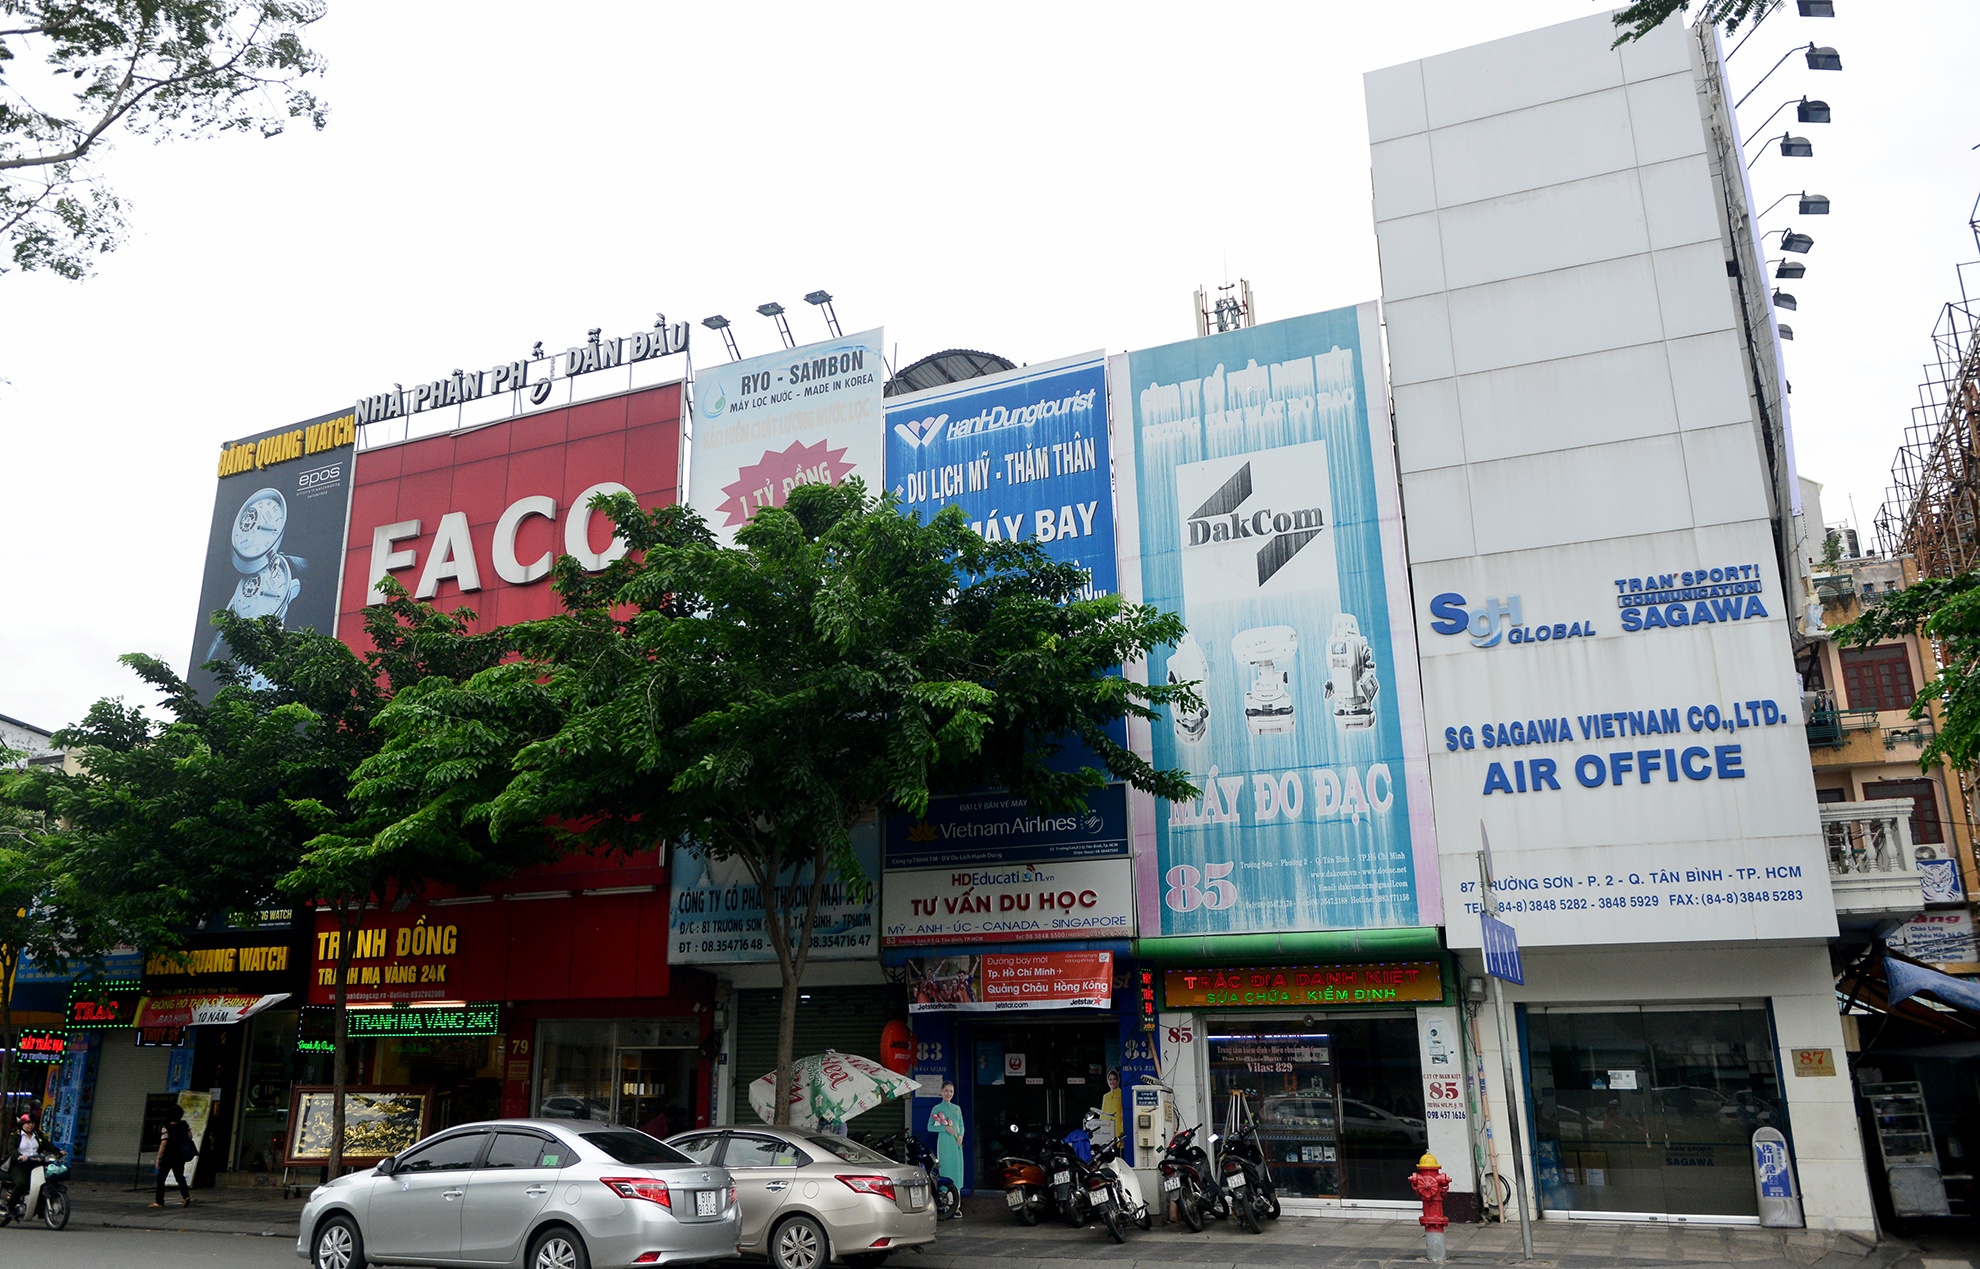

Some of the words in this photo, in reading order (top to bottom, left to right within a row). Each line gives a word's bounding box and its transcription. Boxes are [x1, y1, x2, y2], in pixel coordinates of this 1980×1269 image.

[354, 382, 405, 426] NHÀ
[412, 368, 483, 414] PHÂN
[565, 327, 622, 377] DẪN
[630, 313, 690, 363] ĐẦU
[741, 370, 771, 396] RYO
[789, 349, 864, 386] SAMBON
[730, 399, 749, 414] MÁY
[752, 396, 768, 410] LỌC
[770, 390, 794, 405] NƯỚC
[804, 382, 830, 398] MADE
[832, 380, 842, 391] IN
[844, 372, 874, 388] KOREA
[217, 442, 257, 478] ĐĂNG
[254, 428, 305, 470] QUANG
[304, 413, 355, 456] WATCH
[298, 466, 341, 487] epos
[907, 469, 939, 504] DU
[941, 460, 965, 505] LỊCH
[969, 450, 990, 495] MỸ
[1004, 448, 1050, 485] THĂM
[1053, 430, 1097, 475] THÂN
[1034, 499, 1099, 543] BAY
[1187, 506, 1325, 547] DakCom
[1620, 580, 1760, 606] COMMUNICATION
[1621, 594, 1769, 632] SAGAWA
[1507, 619, 1597, 645] GLOBAL
[1444, 725, 1475, 752] SG
[1481, 716, 1574, 749] SAGAWA
[1577, 706, 1681, 741] VIETNAM
[1482, 757, 1562, 796] AIR
[1573, 743, 1746, 789] OFFICE
[1168, 763, 1245, 827] MÁY
[1252, 770, 1304, 821] ĐO
[1313, 763, 1394, 826] ĐẠC
[940, 821, 1010, 840] Vietnam
[1011, 816, 1077, 834] Airlines
[1165, 860, 1239, 913] 85
[1460, 882, 1476, 893] 87
[1543, 876, 1574, 889] SƠN
[1587, 875, 1601, 888] P.
[1605, 875, 1614, 887] 2
[1628, 873, 1645, 886] Q.
[1649, 869, 1681, 884] TÂN
[1686, 867, 1723, 883] BÌNH
[1735, 868, 1761, 881] TP.
[1765, 865, 1803, 879] HCM
[679, 887, 705, 914] CÔNG
[709, 890, 722, 912] TY
[725, 879, 738, 912] CỔ
[911, 895, 938, 916] TƯ
[944, 886, 992, 915] VẤN
[1000, 893, 1031, 913] DU
[1039, 889, 1098, 914] HỌC
[1560, 898, 1587, 911] 5282
[1598, 896, 1627, 909] 3848
[1630, 895, 1660, 908] 5929
[1772, 889, 1804, 902] 5283
[269, 908, 293, 920] WATCH
[701, 920, 710, 934] 81
[713, 916, 744, 933] TRƯỜNG
[746, 916, 762, 932] SƠN
[843, 912, 872, 927] TPHCM
[887, 923, 907, 935] MỸ
[916, 924, 943, 934] ANH
[953, 920, 972, 933] ÚC
[982, 919, 1040, 932] CANADA
[1052, 915, 1127, 929] SINGAPORE
[396, 914, 458, 957] ĐỒNG
[886, 937, 896, 945] 83
[187, 947, 237, 977] QUANG
[239, 945, 290, 972] WATCH
[986, 956, 1014, 967] Đường
[1015, 956, 1033, 966] bay
[1034, 955, 1049, 964] mới
[987, 969, 1001, 979] Tp.
[1002, 966, 1015, 978] Hồ
[1017, 966, 1032, 977] Chí
[1034, 966, 1056, 976] Minh
[361, 966, 381, 989] MẠ
[384, 961, 417, 984] VÀNG
[420, 963, 447, 983] 24K
[1184, 971, 1242, 990] TRẮC
[1250, 971, 1287, 991] ĐỊA
[1296, 970, 1358, 987] DANH
[1366, 966, 1420, 987] KIỆT
[987, 982, 1020, 996] Quảng
[1021, 981, 1049, 993] Châu
[1053, 979, 1080, 994] Hồng
[1082, 980, 1108, 994] Kông
[1206, 988, 1240, 1004] SỬA
[1244, 988, 1290, 1004] CHỮA
[1306, 984, 1349, 1002] KIỂM
[1354, 987, 1397, 1003] ĐỊNH
[198, 1012, 207, 1023] 10
[207, 1009, 228, 1022] NĂM
[995, 1001, 1029, 1010] jetstar.com
[1070, 998, 1094, 1007] Jetstar
[353, 1014, 400, 1030] TRANH
[400, 1013, 423, 1034] MẠ
[424, 1008, 465, 1029] VÀNG
[466, 1011, 496, 1028] 24K
[512, 1039, 529, 1055] 79
[1167, 1026, 1193, 1044] 85
[916, 1041, 943, 1061] 83
[1124, 1039, 1154, 1060] 83
[1800, 1051, 1825, 1065] 87
[1247, 1062, 1274, 1073] Vilas:
[1275, 1062, 1293, 1073] 829
[1429, 1081, 1459, 1100] 85
[1427, 1111, 1439, 1119] 098
[1440, 1111, 1451, 1119] 457
[1452, 1111, 1467, 1120] 1626
[1665, 1157, 1715, 1167] SAGAWA
[701, 1192, 711, 1203] 51F
